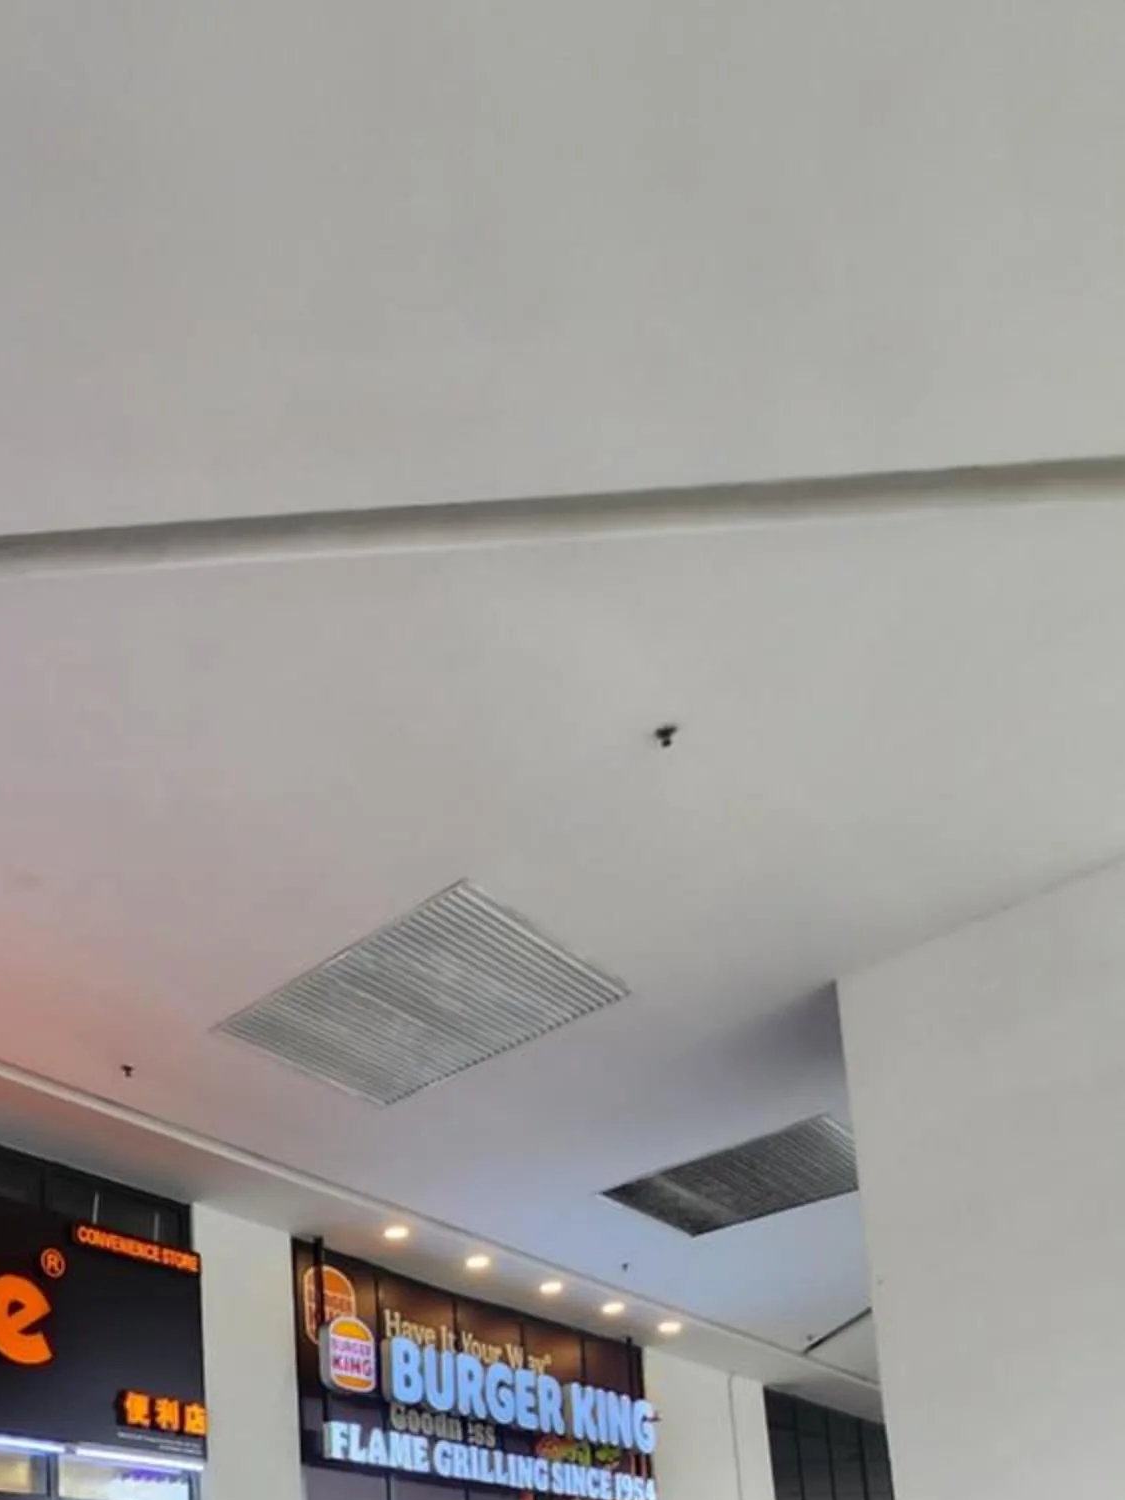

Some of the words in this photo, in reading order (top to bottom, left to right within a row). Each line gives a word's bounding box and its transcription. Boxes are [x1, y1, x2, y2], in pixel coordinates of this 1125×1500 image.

[77, 1226, 160, 1262] CONVENIENCE
[162, 1248, 199, 1273] STORE
[383, 1308, 436, 1345] Have
[331, 1356, 373, 1377] KING
[389, 1335, 565, 1435] BURGER
[569, 1381, 656, 1454] KING
[328, 1420, 430, 1473] FLAME
[433, 1440, 549, 1491] GRILLING
[551, 1461, 613, 1500] SINCE
